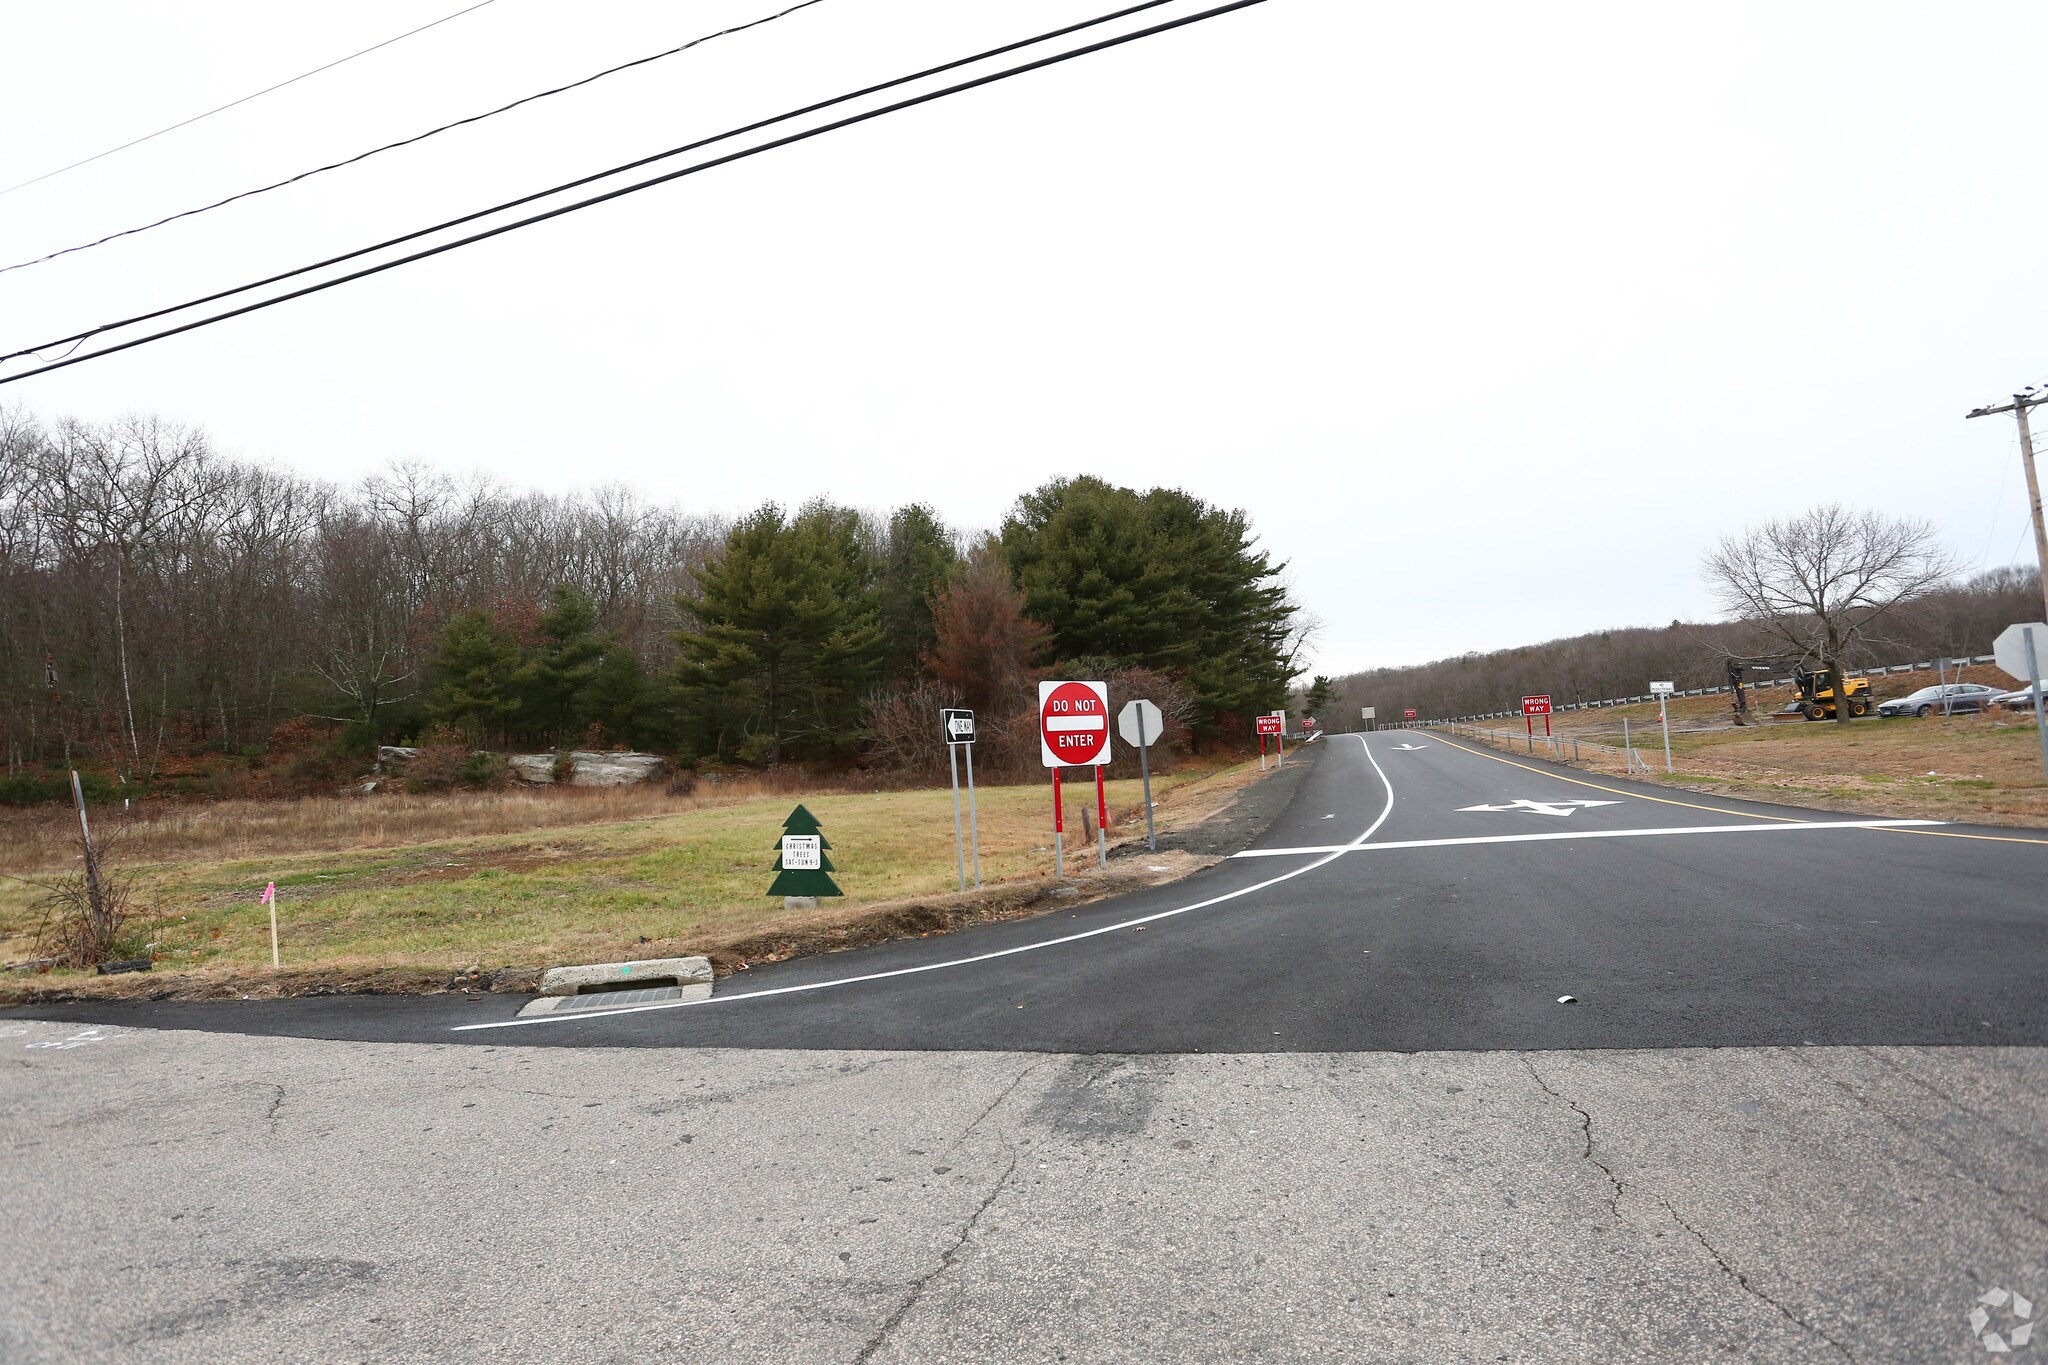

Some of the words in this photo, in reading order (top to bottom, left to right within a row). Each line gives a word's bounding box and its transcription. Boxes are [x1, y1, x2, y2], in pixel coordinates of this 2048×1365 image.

[1053, 700, 1068, 712] DO
[1074, 700, 1096, 712] NOT
[954, 720, 964, 732] ONE
[964, 720, 972, 732] WAY
[1058, 734, 1094, 748] ENTER
